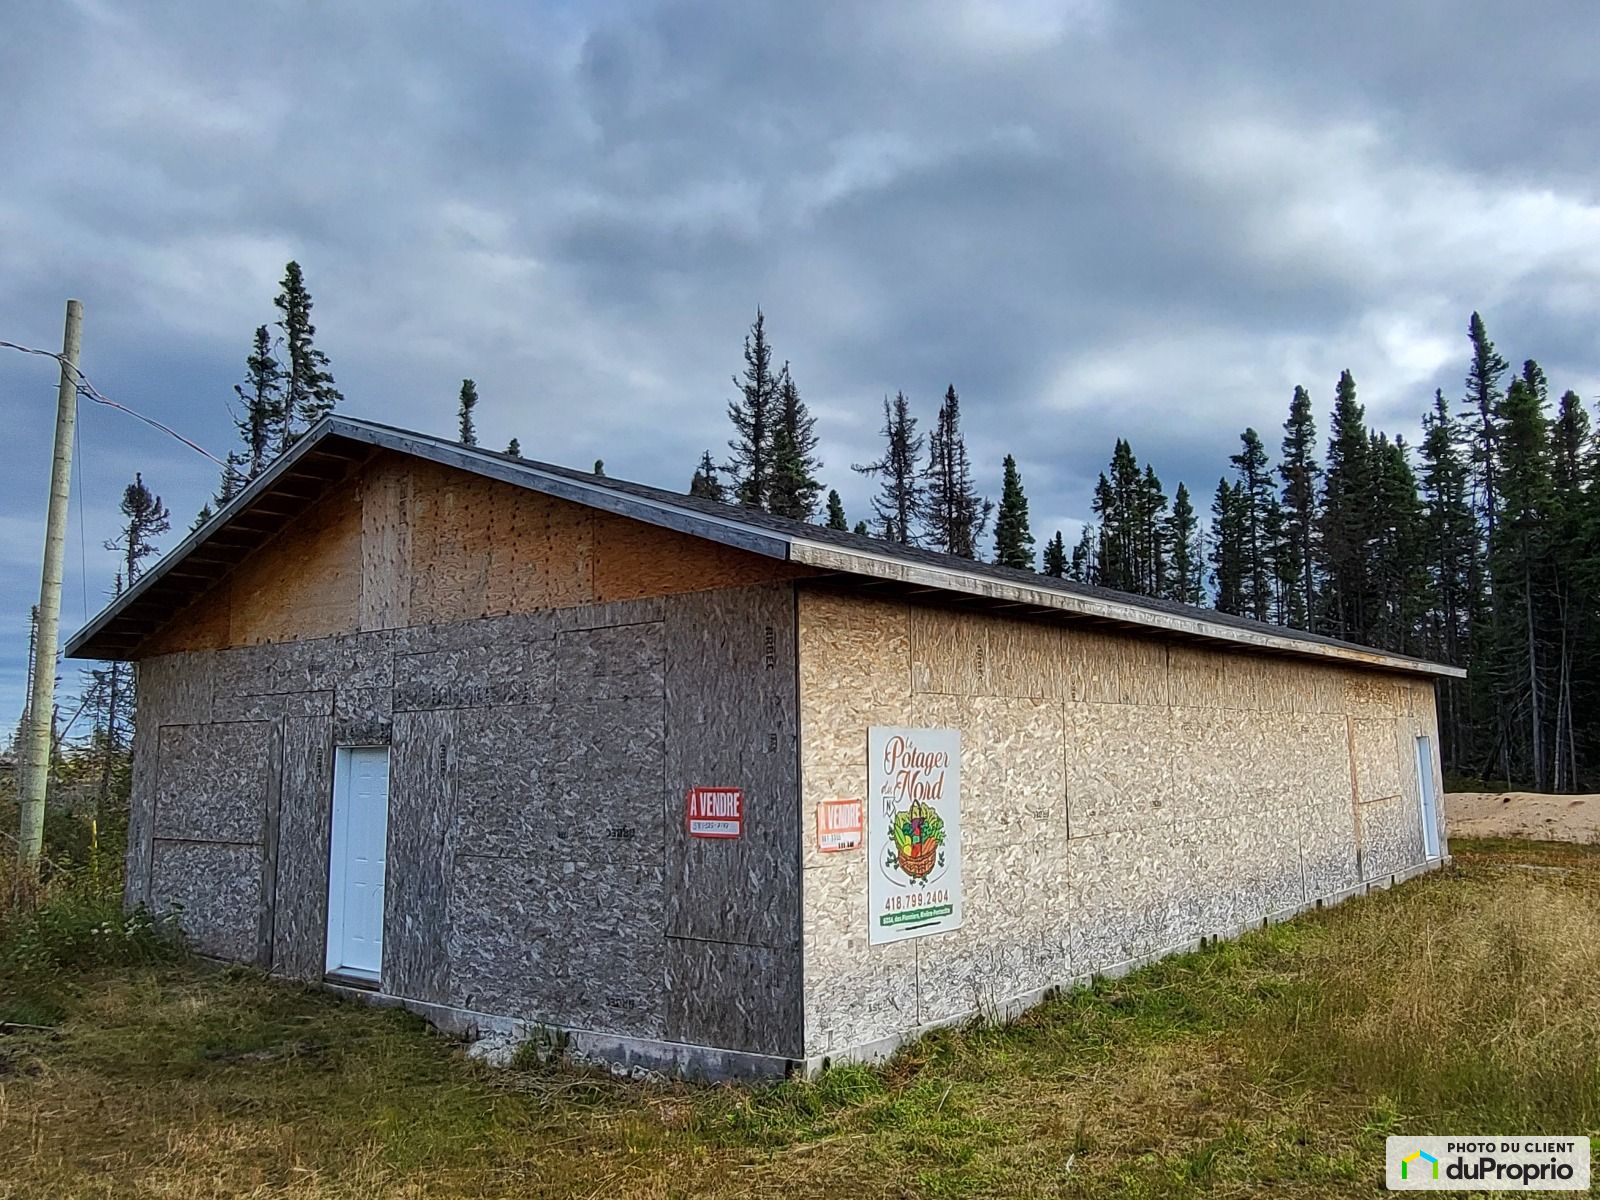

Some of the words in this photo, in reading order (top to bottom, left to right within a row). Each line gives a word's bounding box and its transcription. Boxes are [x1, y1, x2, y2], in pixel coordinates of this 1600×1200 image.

[884, 735, 950, 777] Potager
[881, 780, 893, 794] du
[893, 769, 945, 803] Nord
[700, 792, 740, 817] VENDRE
[829, 804, 861, 829] VENDRE
[885, 889, 949, 911] 418.799.2404
